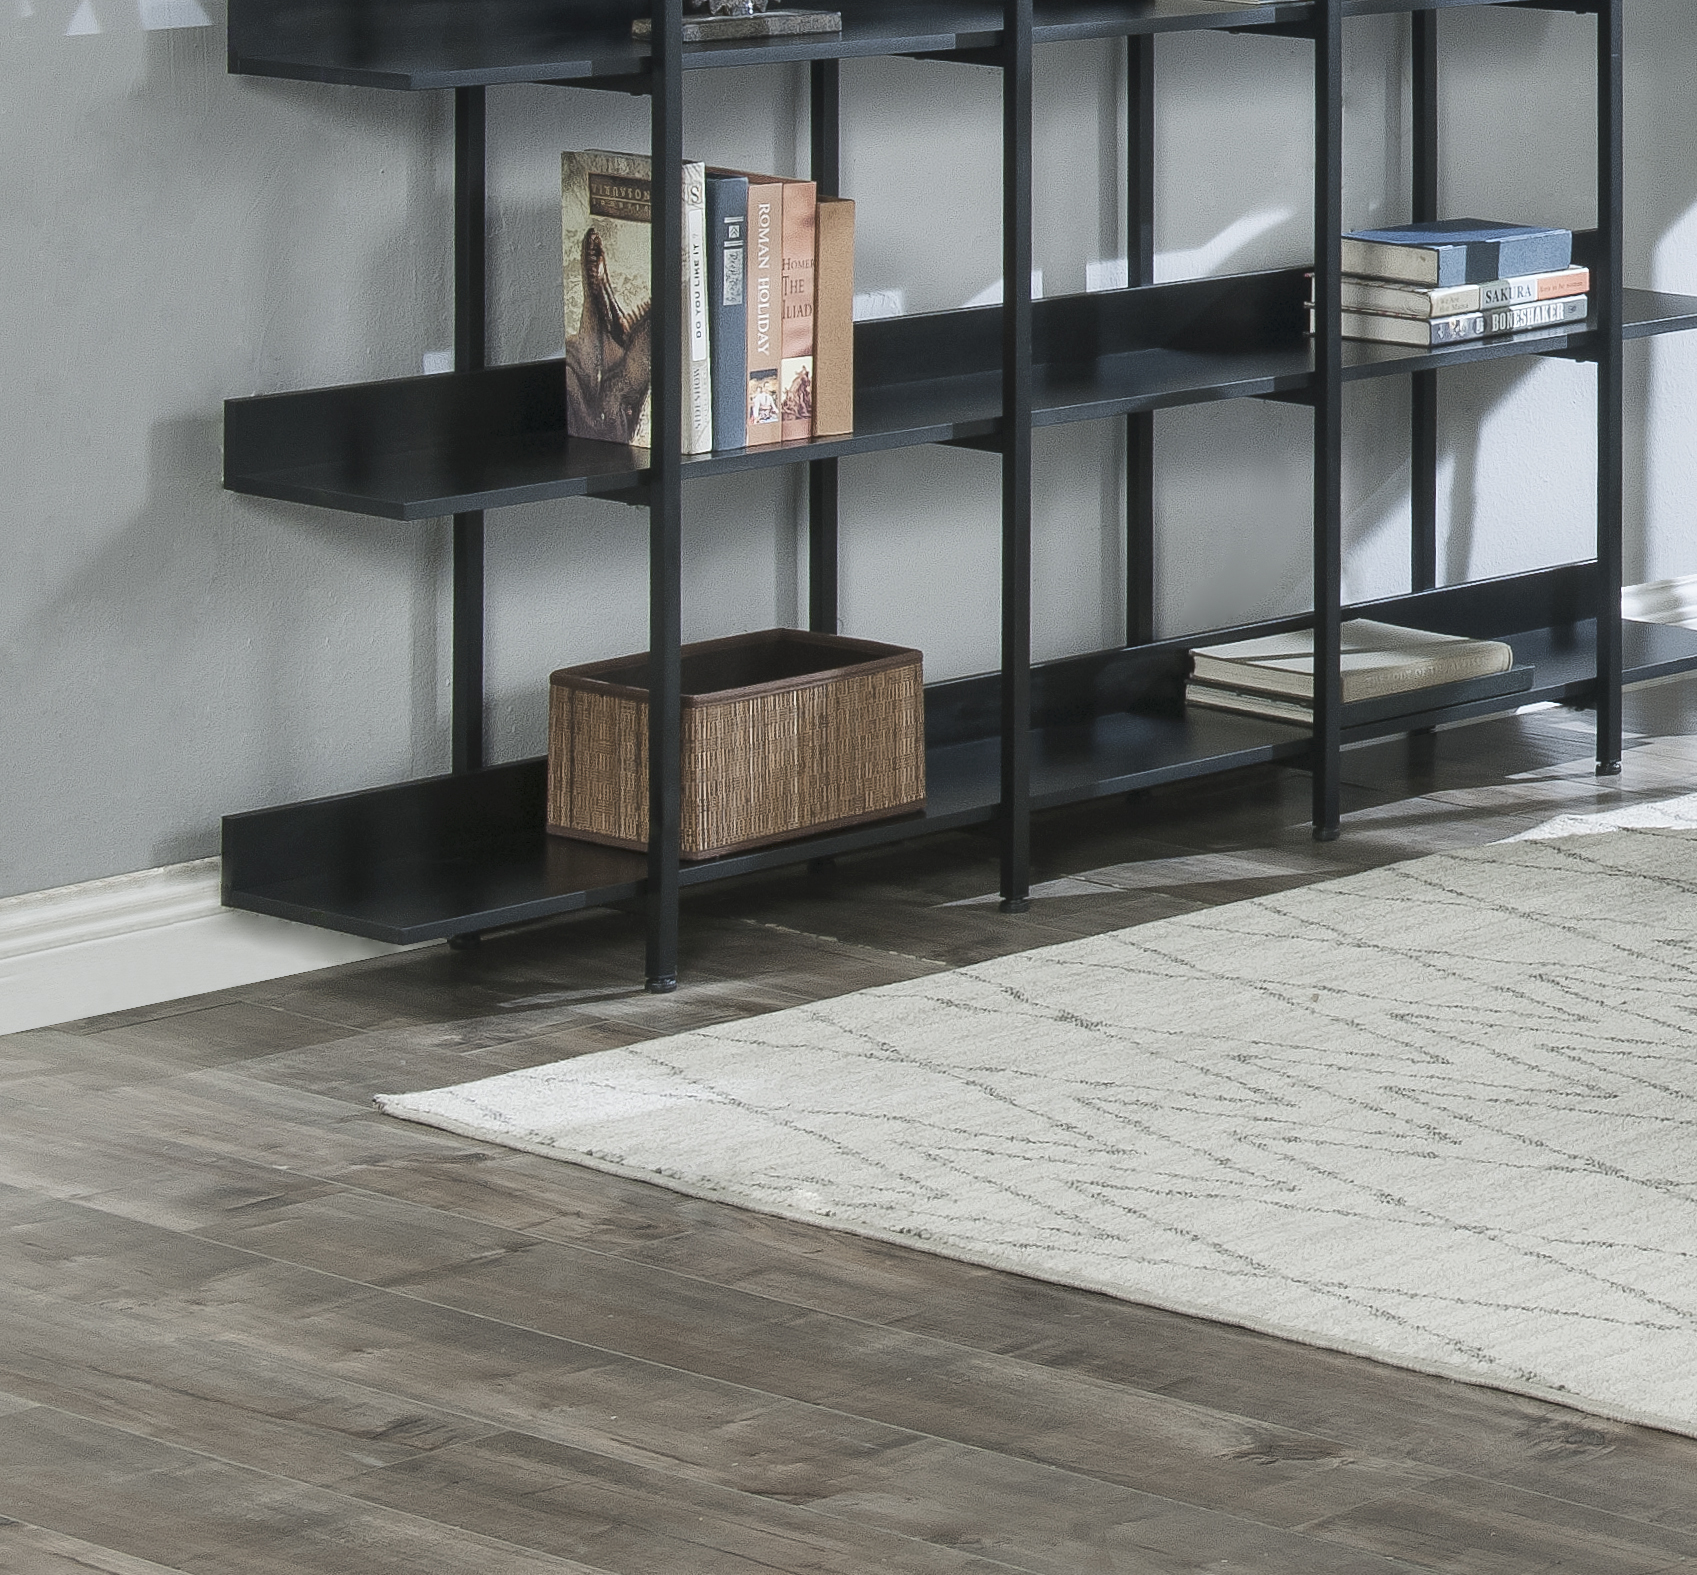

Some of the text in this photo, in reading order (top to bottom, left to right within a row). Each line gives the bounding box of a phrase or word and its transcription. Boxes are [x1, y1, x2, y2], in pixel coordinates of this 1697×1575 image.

[692, 244, 700, 255] IT
[782, 257, 815, 272] HOMER
[757, 203, 771, 356] ROMAN HOLIDAY
[782, 275, 805, 297] THE
[1485, 284, 1532, 304] SAKURA
[782, 299, 813, 320] ILIAD
[1491, 302, 1565, 332] BONESHAKER
[694, 321, 702, 339] DO
[693, 368, 701, 430] SIDESHOW
